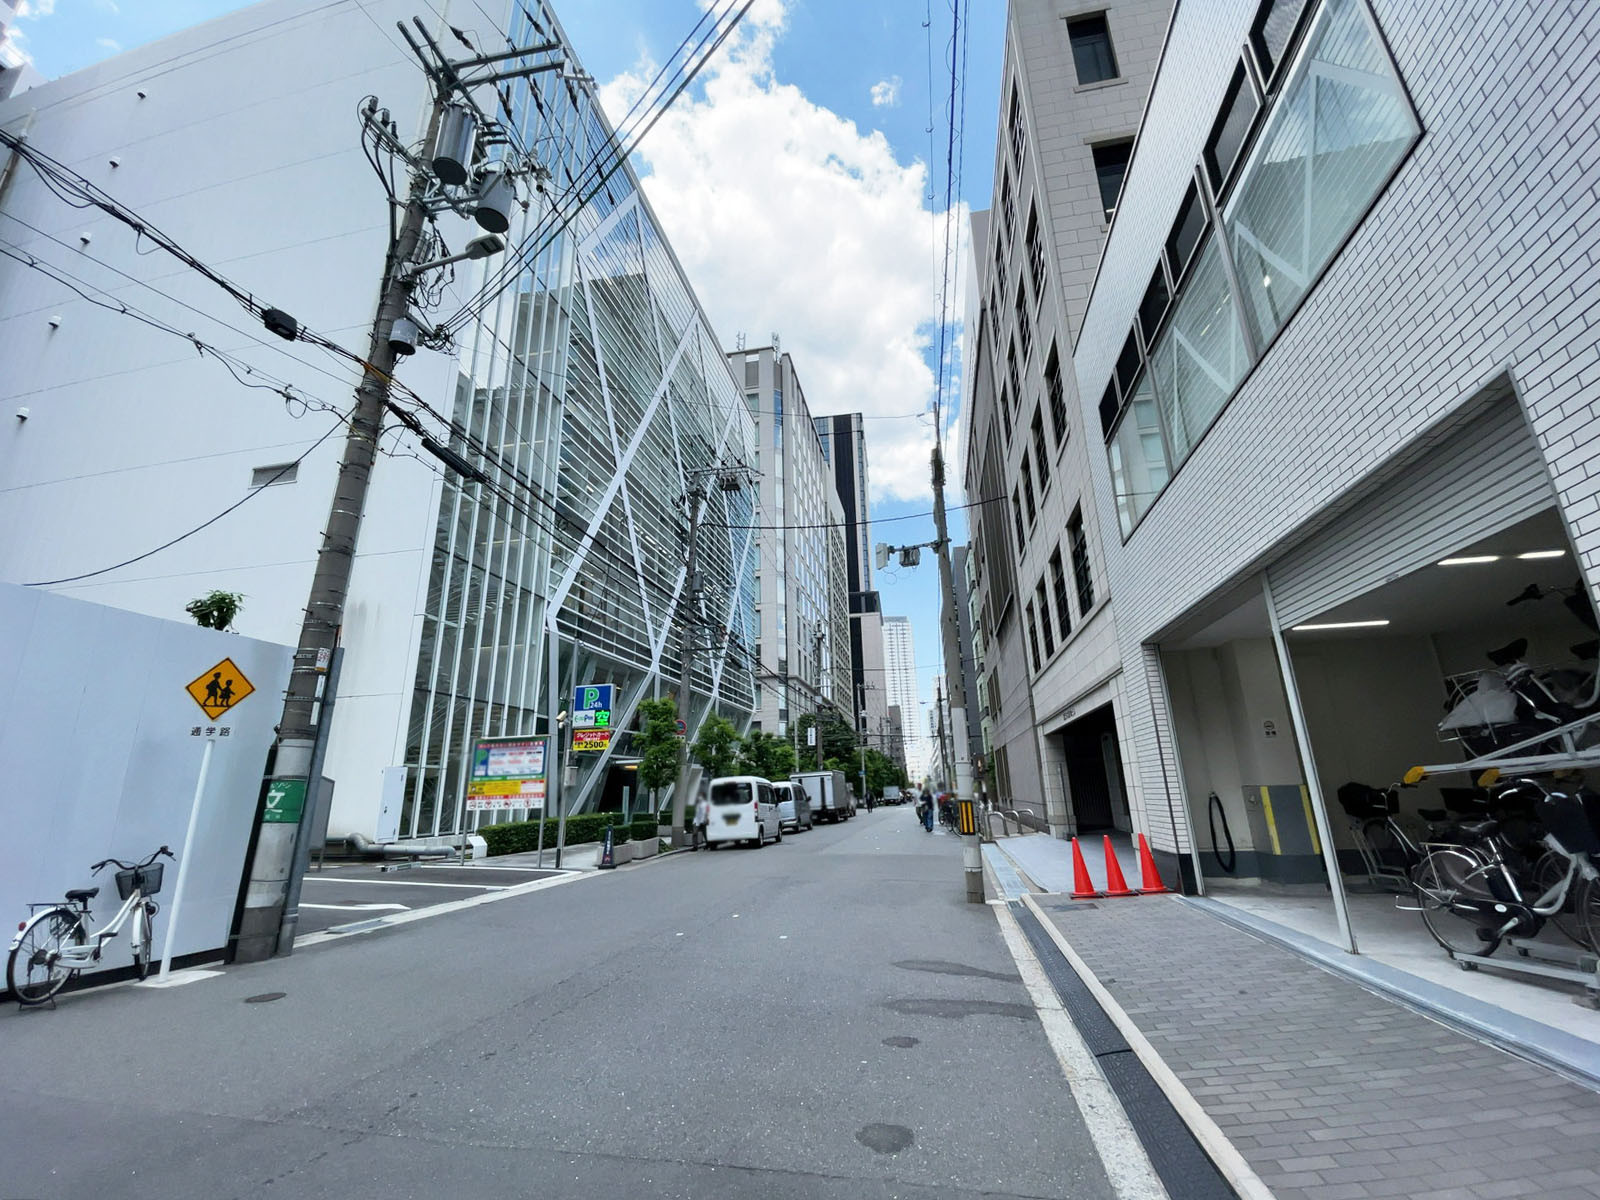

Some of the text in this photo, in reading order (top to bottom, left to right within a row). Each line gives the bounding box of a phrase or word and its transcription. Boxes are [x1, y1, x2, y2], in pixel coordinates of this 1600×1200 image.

[583, 688, 600, 709] P
[190, 726, 231, 737] 通学路
